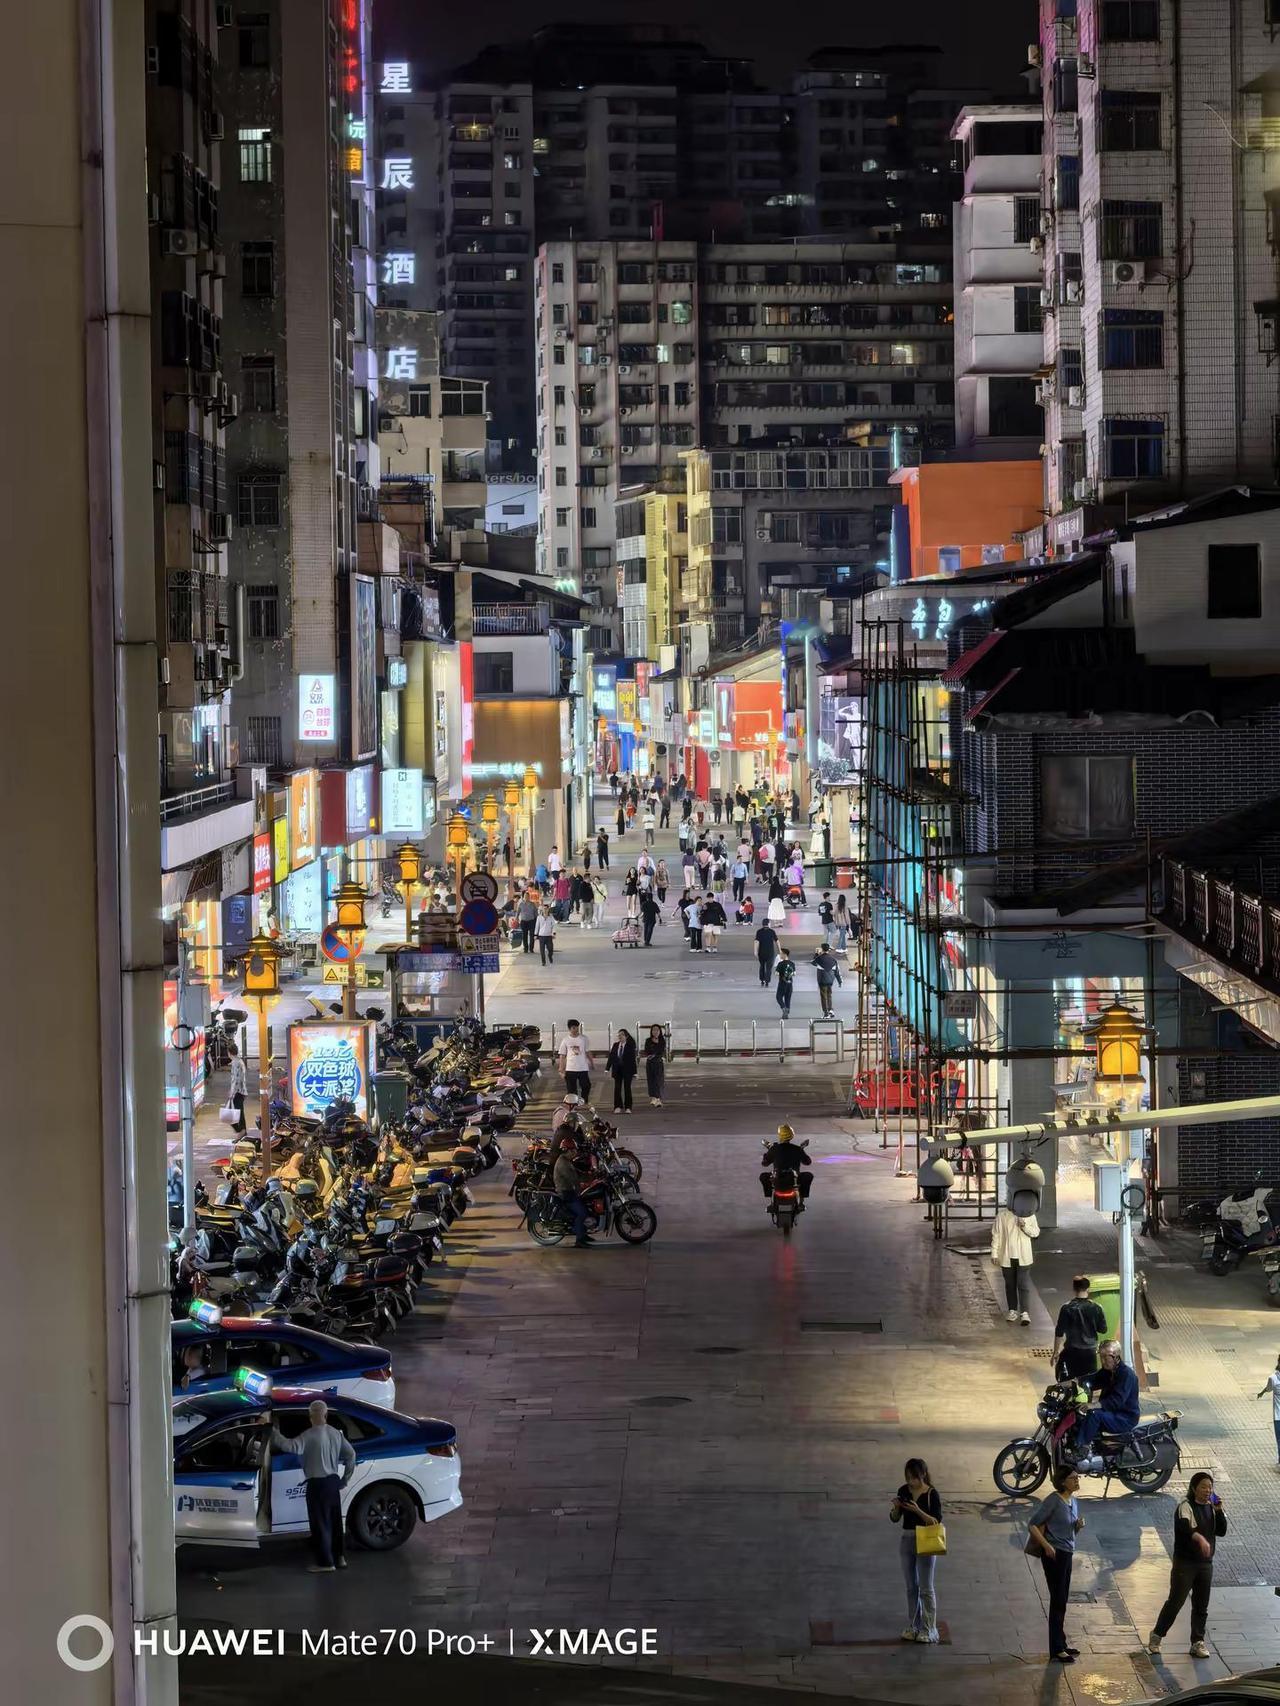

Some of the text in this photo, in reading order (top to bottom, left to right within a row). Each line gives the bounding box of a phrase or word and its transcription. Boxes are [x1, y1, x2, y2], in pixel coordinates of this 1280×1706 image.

[380, 62, 418, 380] 星辰酒店
[303, 1060, 355, 1079] 双色球
[304, 1080, 354, 1097] 大派奖
